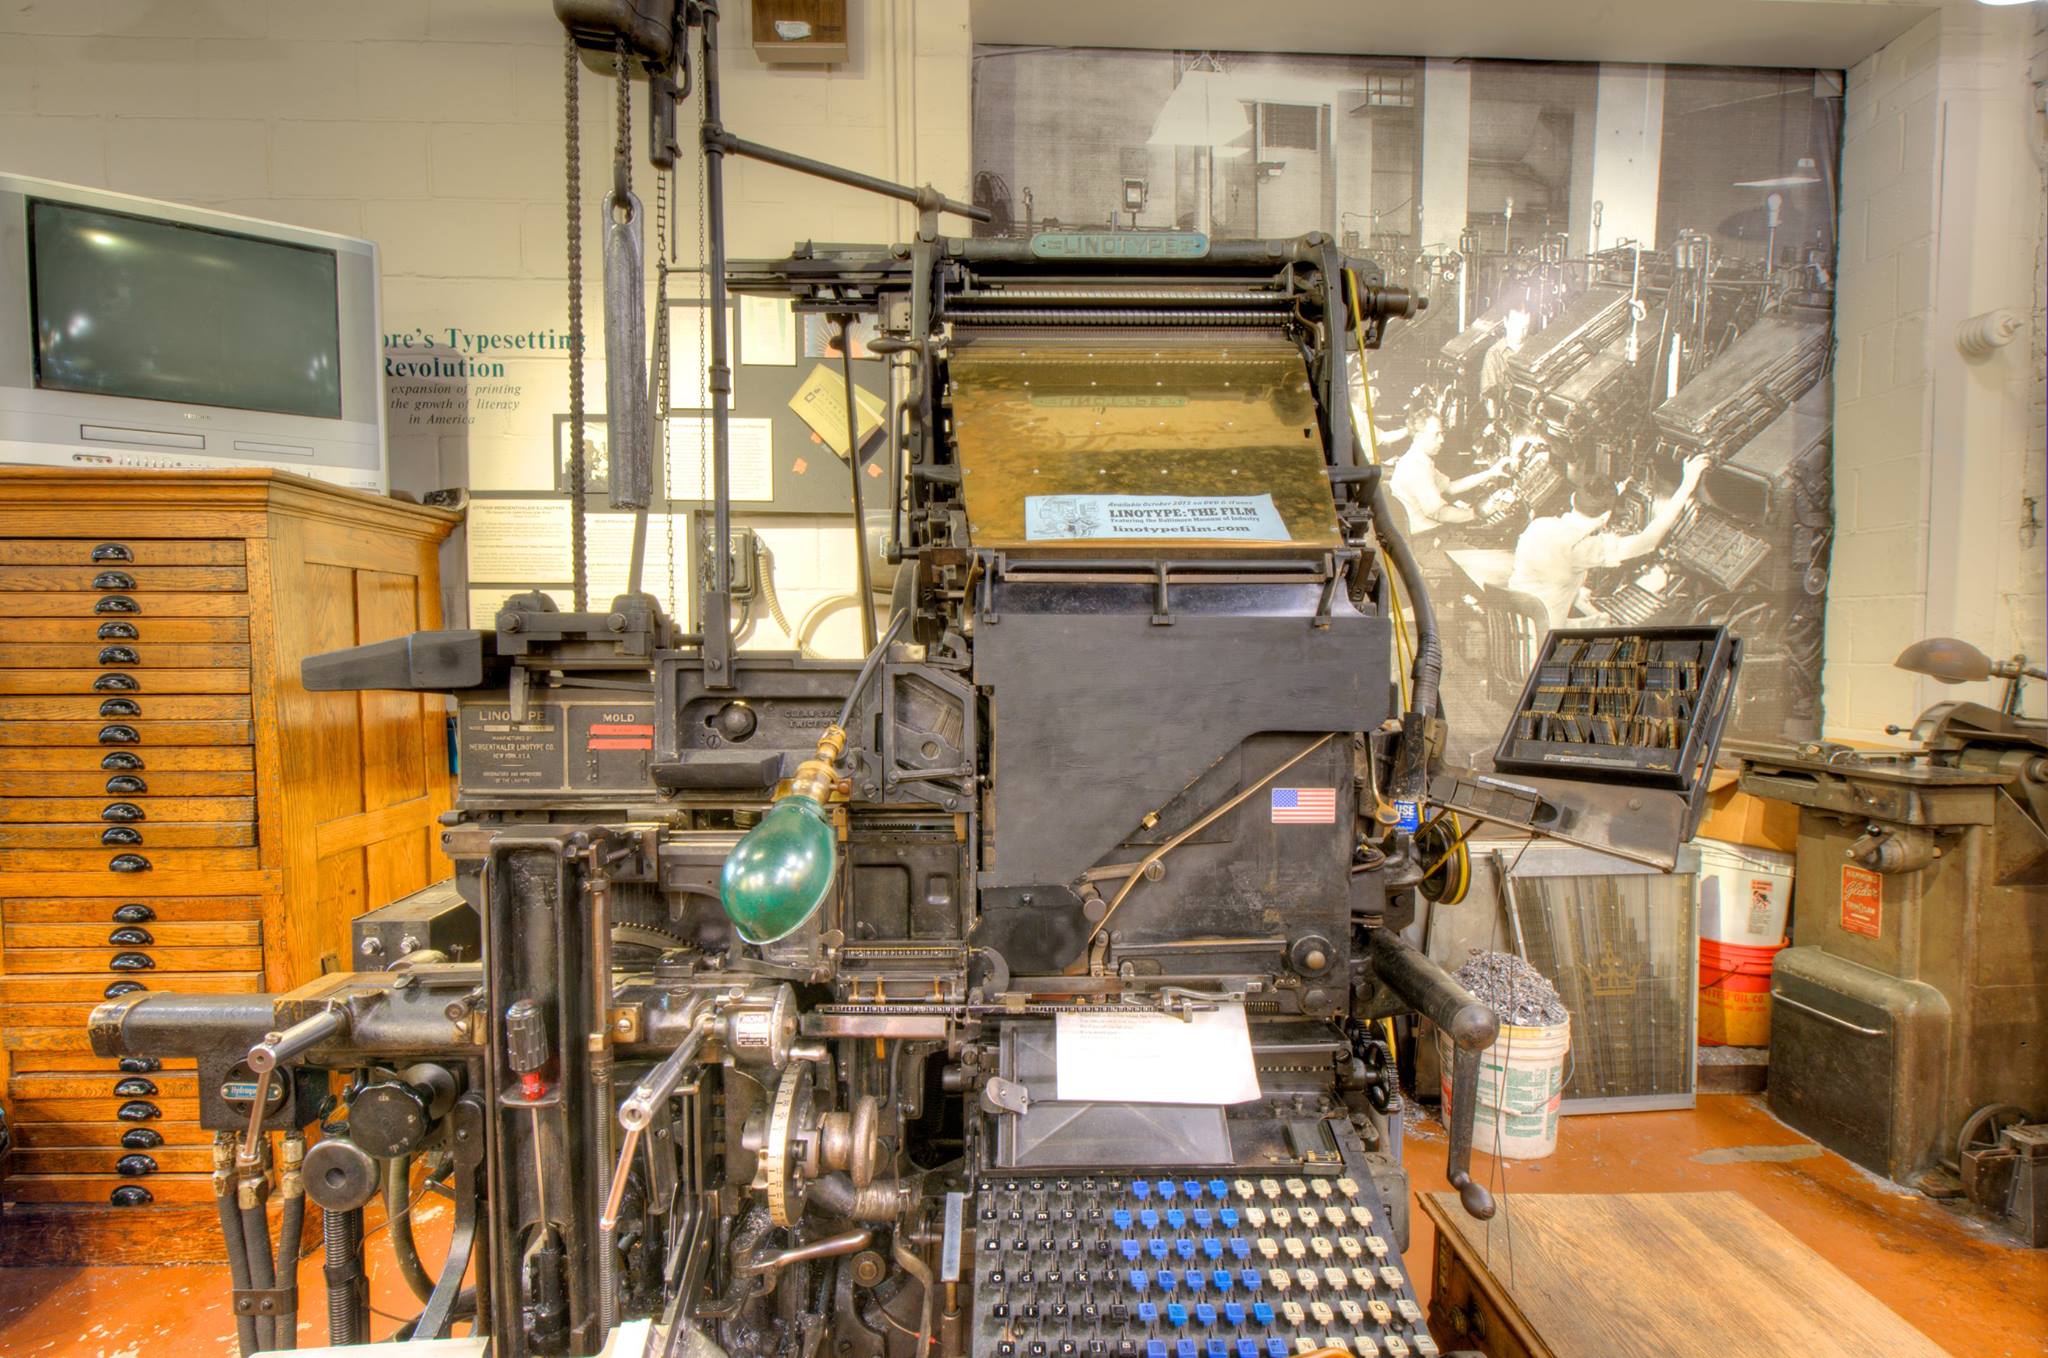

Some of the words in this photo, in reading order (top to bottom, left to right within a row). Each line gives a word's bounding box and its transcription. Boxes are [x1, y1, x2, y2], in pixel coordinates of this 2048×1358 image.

[1064, 237, 1177, 254] LINOTYPE
[445, 328, 586, 353] Typesettin
[385, 357, 505, 378] Revolution
[391, 385, 451, 396] expansion
[456, 384, 469, 396] of
[475, 385, 521, 396] printing
[390, 399, 409, 410] the
[414, 399, 452, 411] growth
[458, 399, 470, 411] of
[477, 399, 520, 411] literacy
[409, 415, 420, 425] in
[427, 415, 476, 425] America
[1109, 509, 1187, 518] LINOTYPE:
[1188, 508, 1218, 517] THE
[1220, 507, 1258, 516] FILM
[1113, 525, 1250, 533] linotypefilm.com
[479, 711, 544, 720] LINOPE
[602, 713, 635, 722] MOLD
